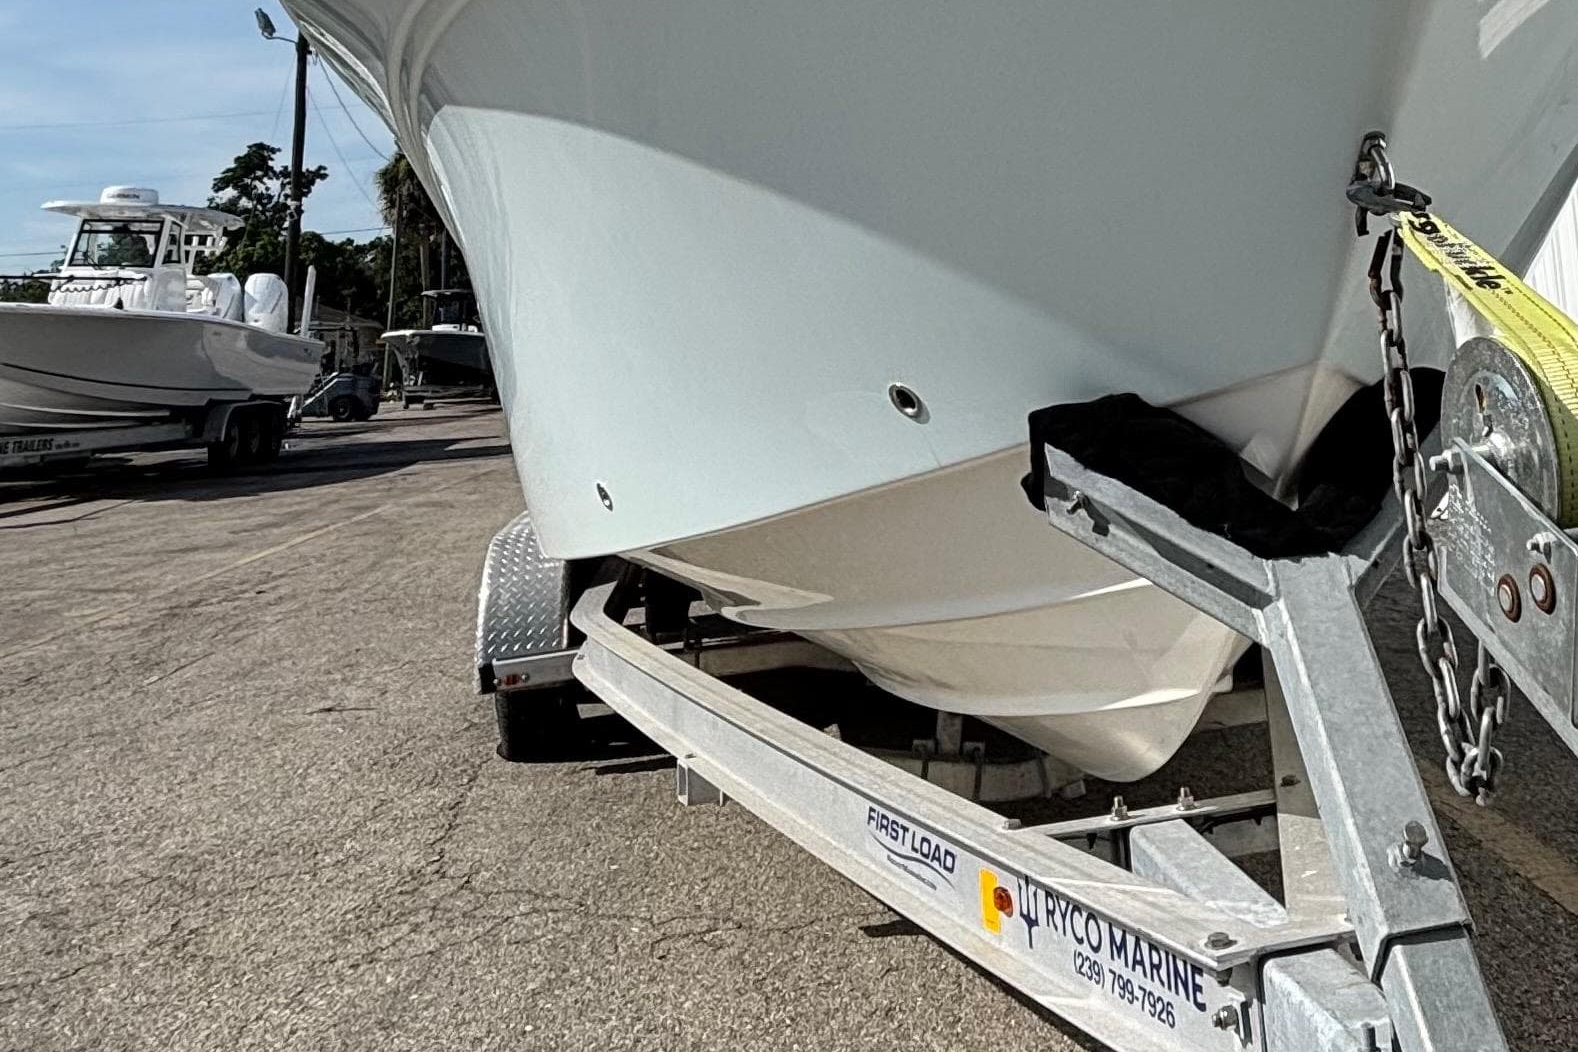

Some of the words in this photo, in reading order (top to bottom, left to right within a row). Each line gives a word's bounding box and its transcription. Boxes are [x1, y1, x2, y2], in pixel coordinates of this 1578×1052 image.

[867, 806, 909, 846] FIRST
[911, 830, 956, 874] LOAD
[1045, 890, 1102, 954] RYCO
[1109, 922, 1206, 1012] MARINE
[1073, 949, 1105, 990] (239)
[1108, 968, 1175, 1029] 799-7926
